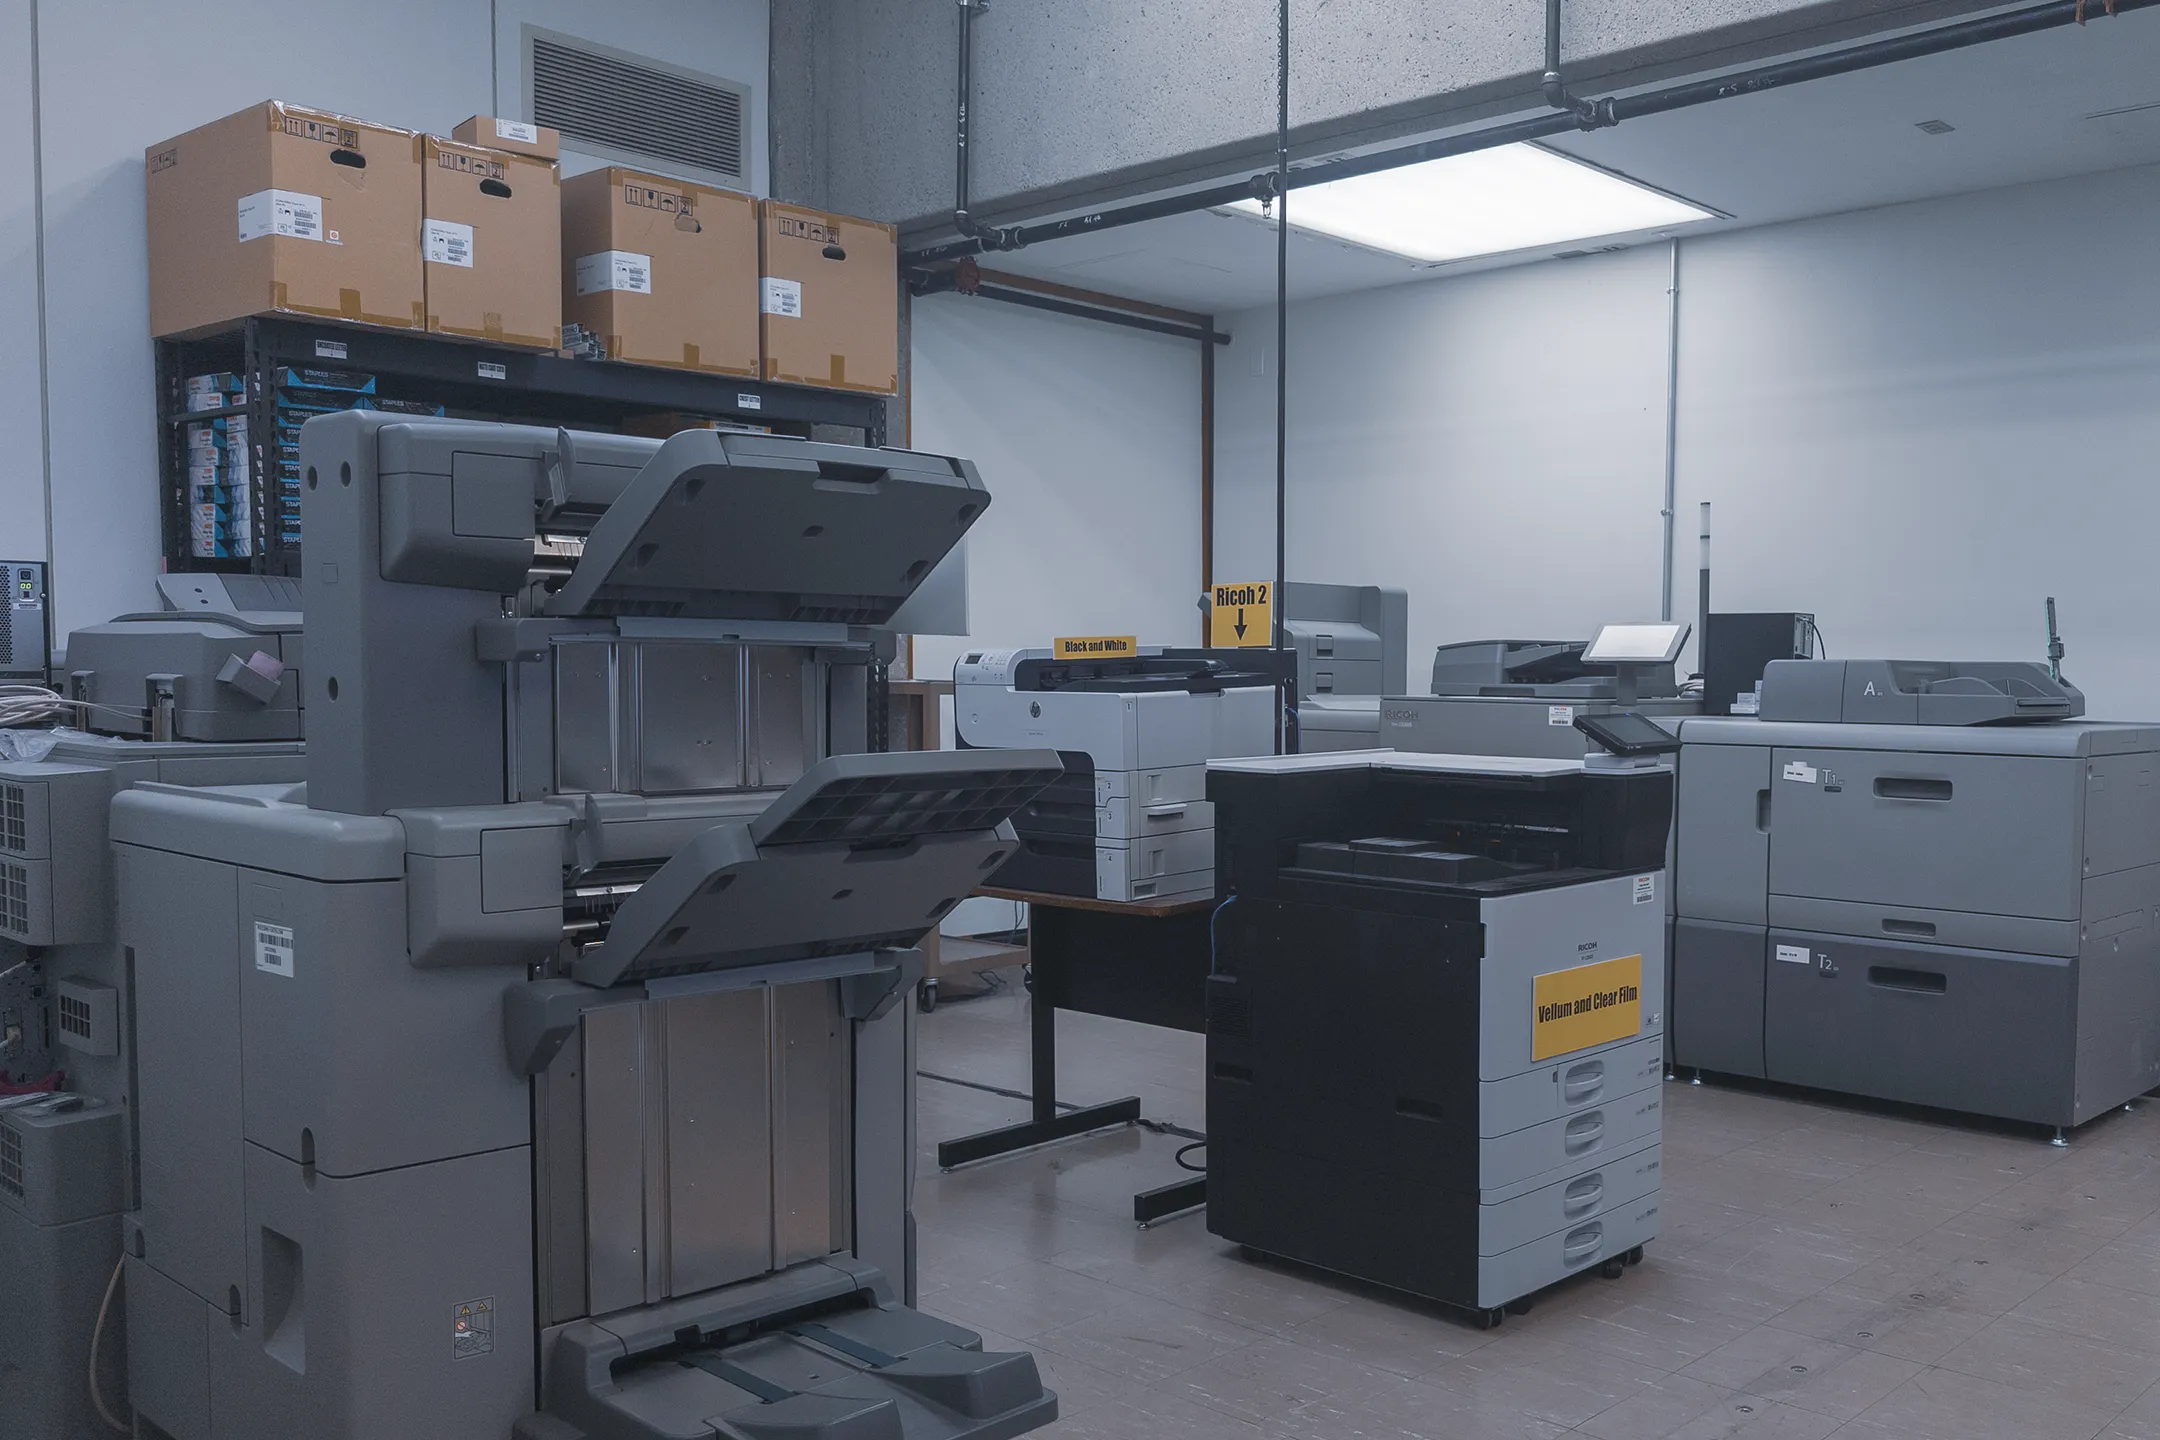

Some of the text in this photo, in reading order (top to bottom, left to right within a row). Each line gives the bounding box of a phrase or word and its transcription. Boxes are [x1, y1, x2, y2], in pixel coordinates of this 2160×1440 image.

[304, 369, 329, 378] STAPLES
[382, 399, 404, 407] STAPLES
[288, 410, 313, 418] STAPLES
[1216, 584, 1267, 606] Ricoh 2
[1065, 640, 1127, 653] Black and White
[1863, 680, 1876, 696] A
[1384, 709, 1419, 720] RICOH
[1106, 782, 1112, 790] 2
[1107, 812, 1113, 820] 3
[1577, 941, 1598, 952] RICOH
[1538, 985, 1638, 1023] Vellum and Clear Film
